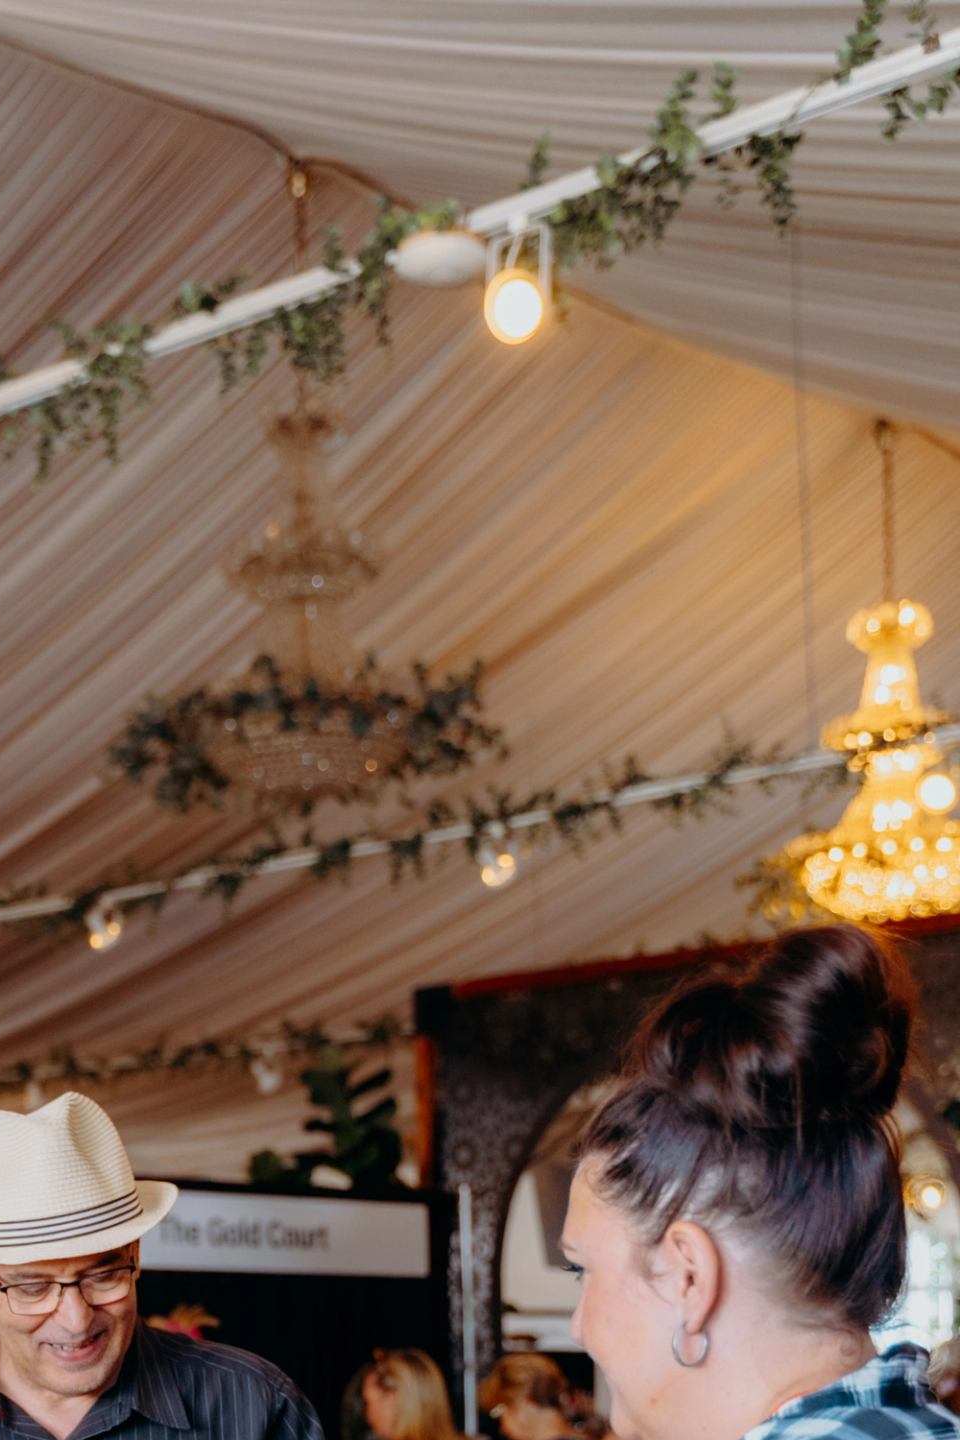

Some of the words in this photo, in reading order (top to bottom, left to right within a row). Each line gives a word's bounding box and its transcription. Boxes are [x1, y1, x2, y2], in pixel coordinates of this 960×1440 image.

[161, 1217, 201, 1245] The
[208, 1217, 261, 1247] Gold
[268, 1220, 331, 1250] Court
